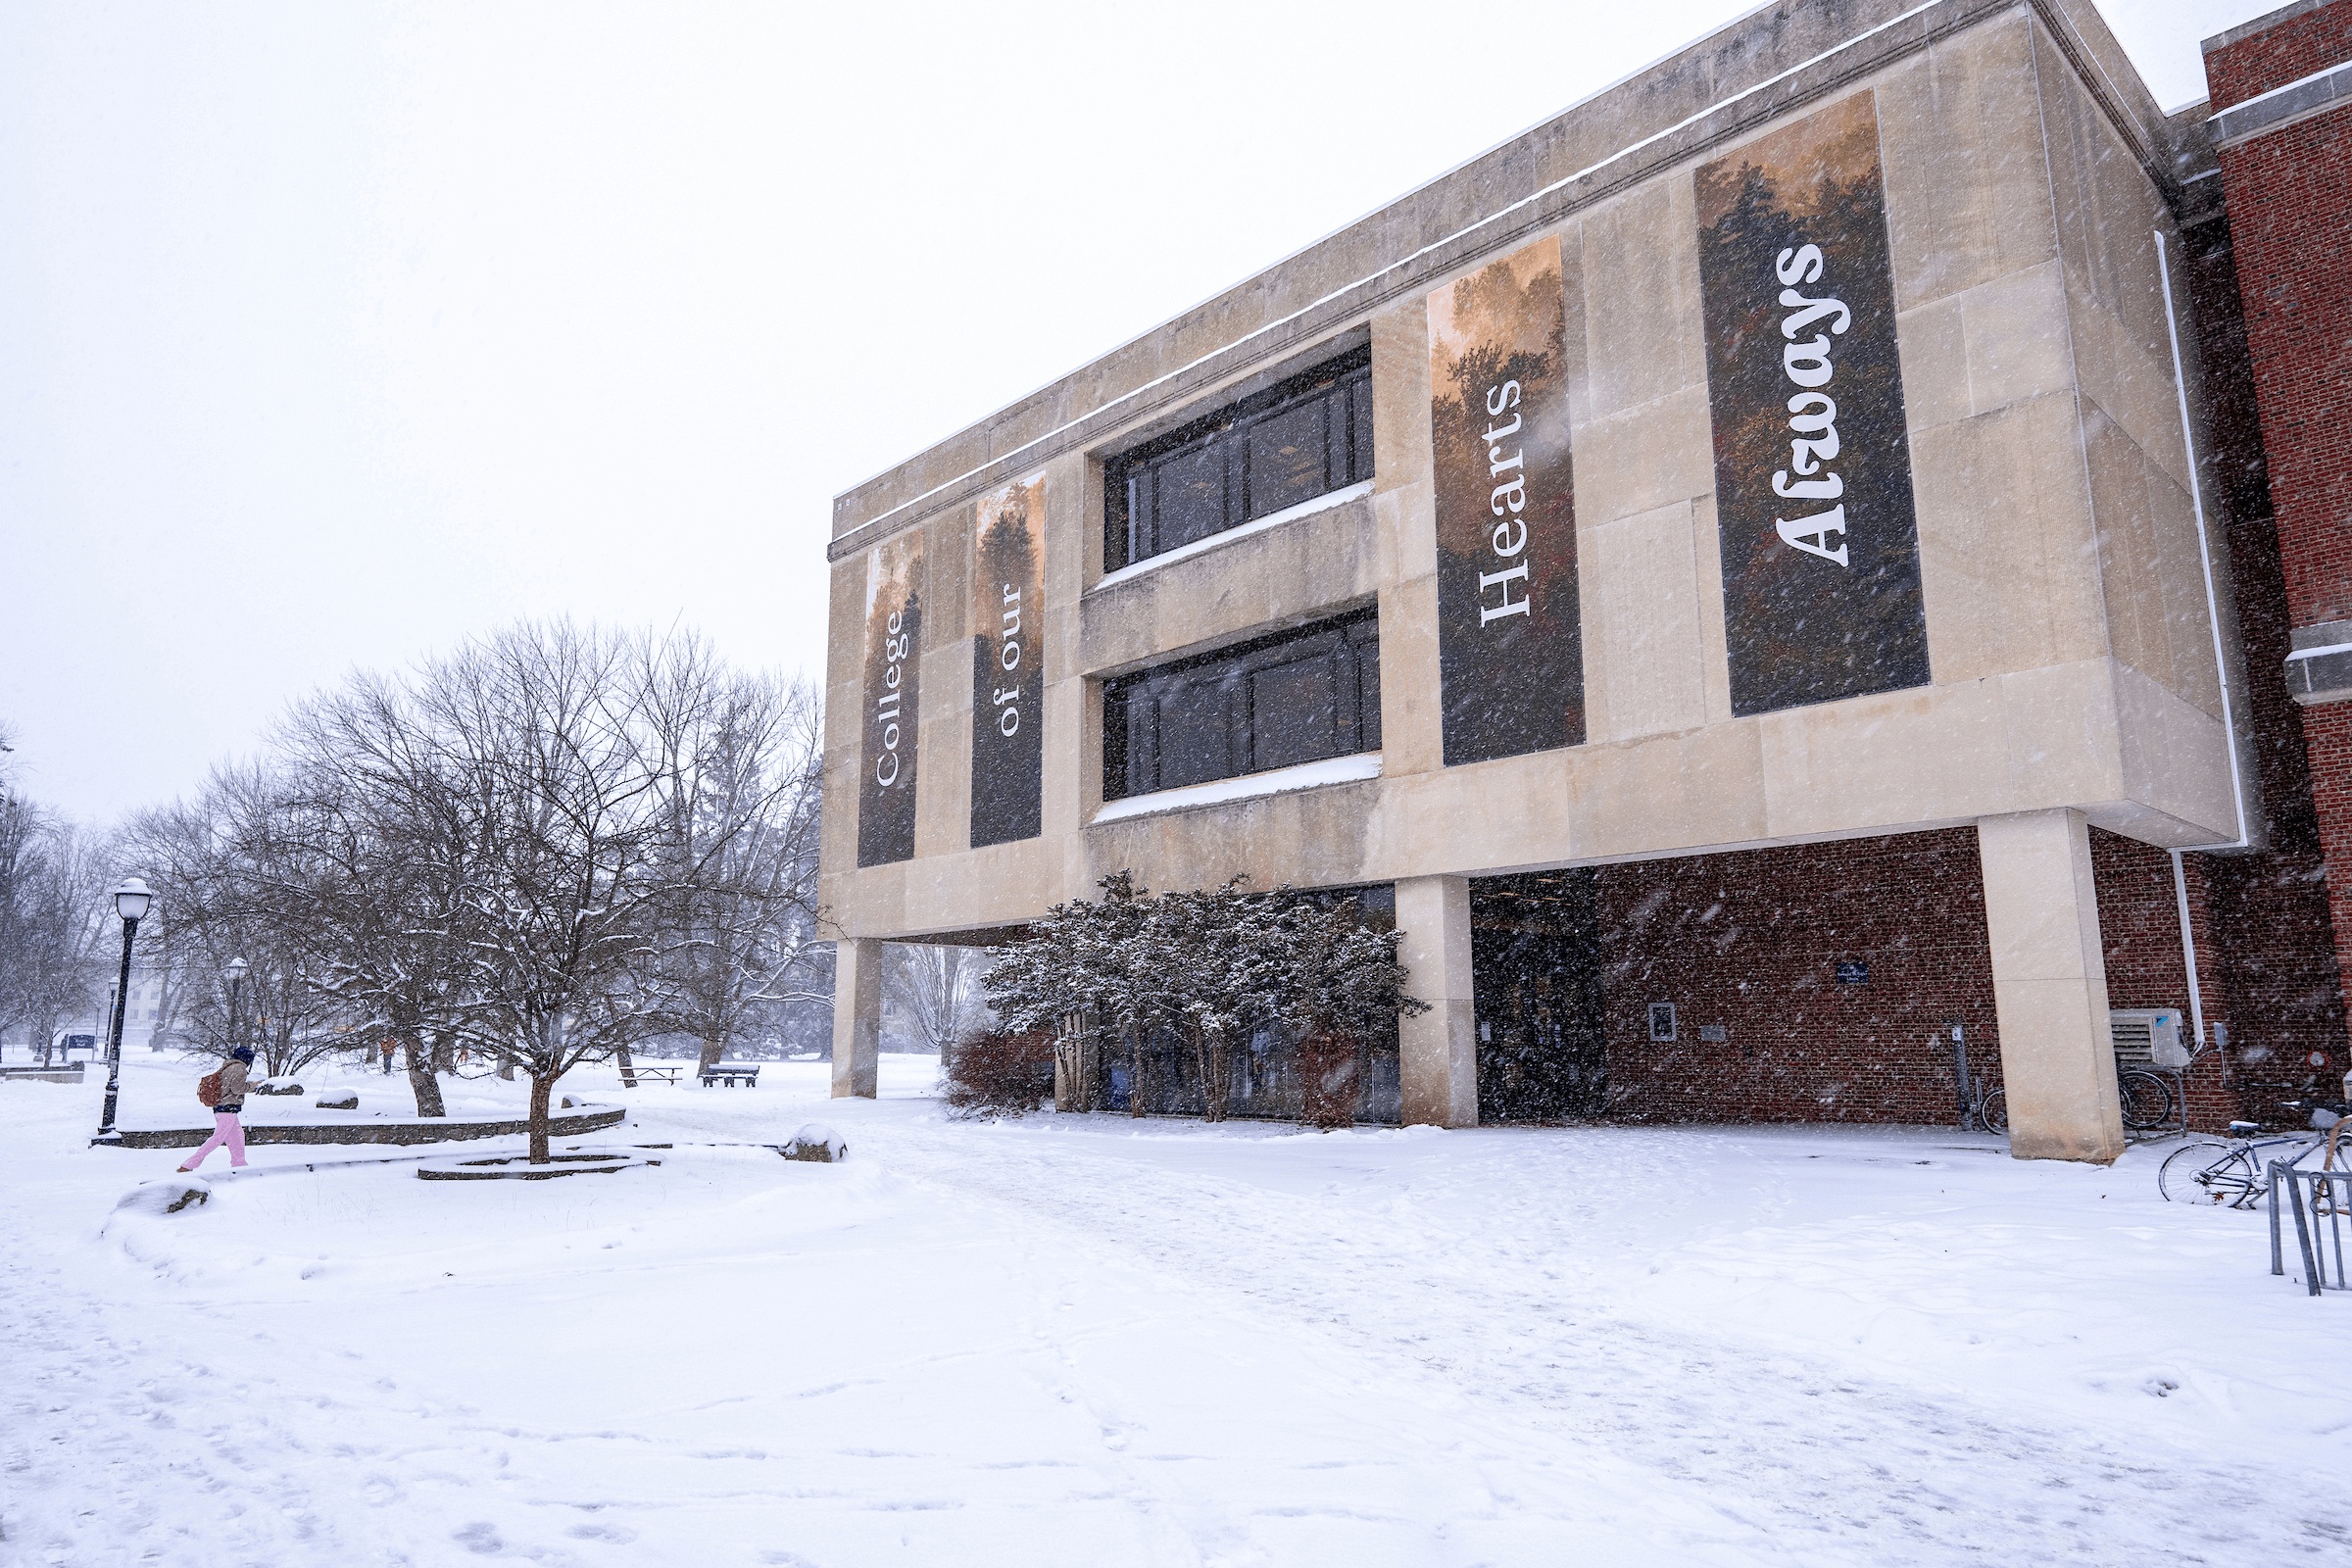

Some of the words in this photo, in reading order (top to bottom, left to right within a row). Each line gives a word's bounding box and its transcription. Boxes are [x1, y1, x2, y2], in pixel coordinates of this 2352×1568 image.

[1771, 243, 1851, 567] Always
[1480, 379, 1530, 628] Hearts
[877, 611, 907, 787] College
[994, 685, 1019, 737] of
[1002, 583, 1020, 670] our
